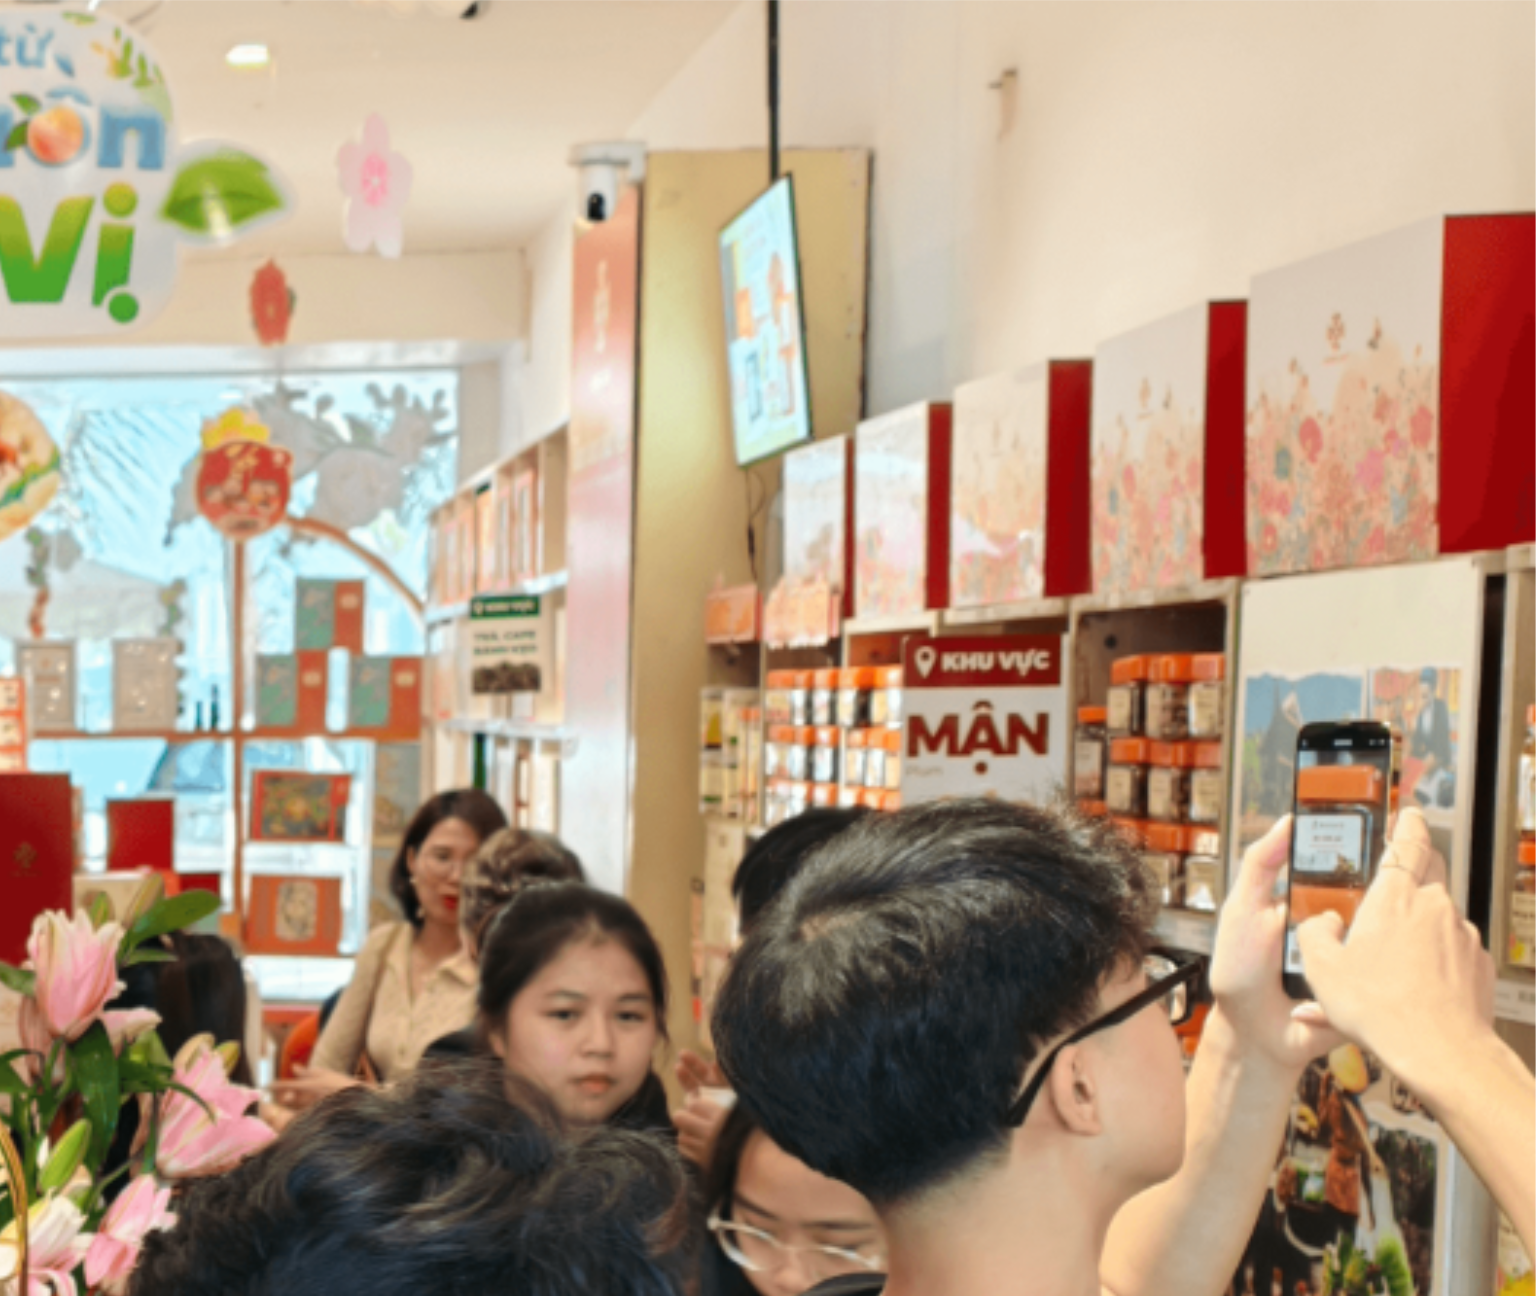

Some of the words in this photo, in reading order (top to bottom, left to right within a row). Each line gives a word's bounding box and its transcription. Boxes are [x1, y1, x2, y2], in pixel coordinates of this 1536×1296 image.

[941, 650, 995, 673] KHU
[998, 647, 1051, 677] VỰC
[906, 699, 1051, 776] MẬN
